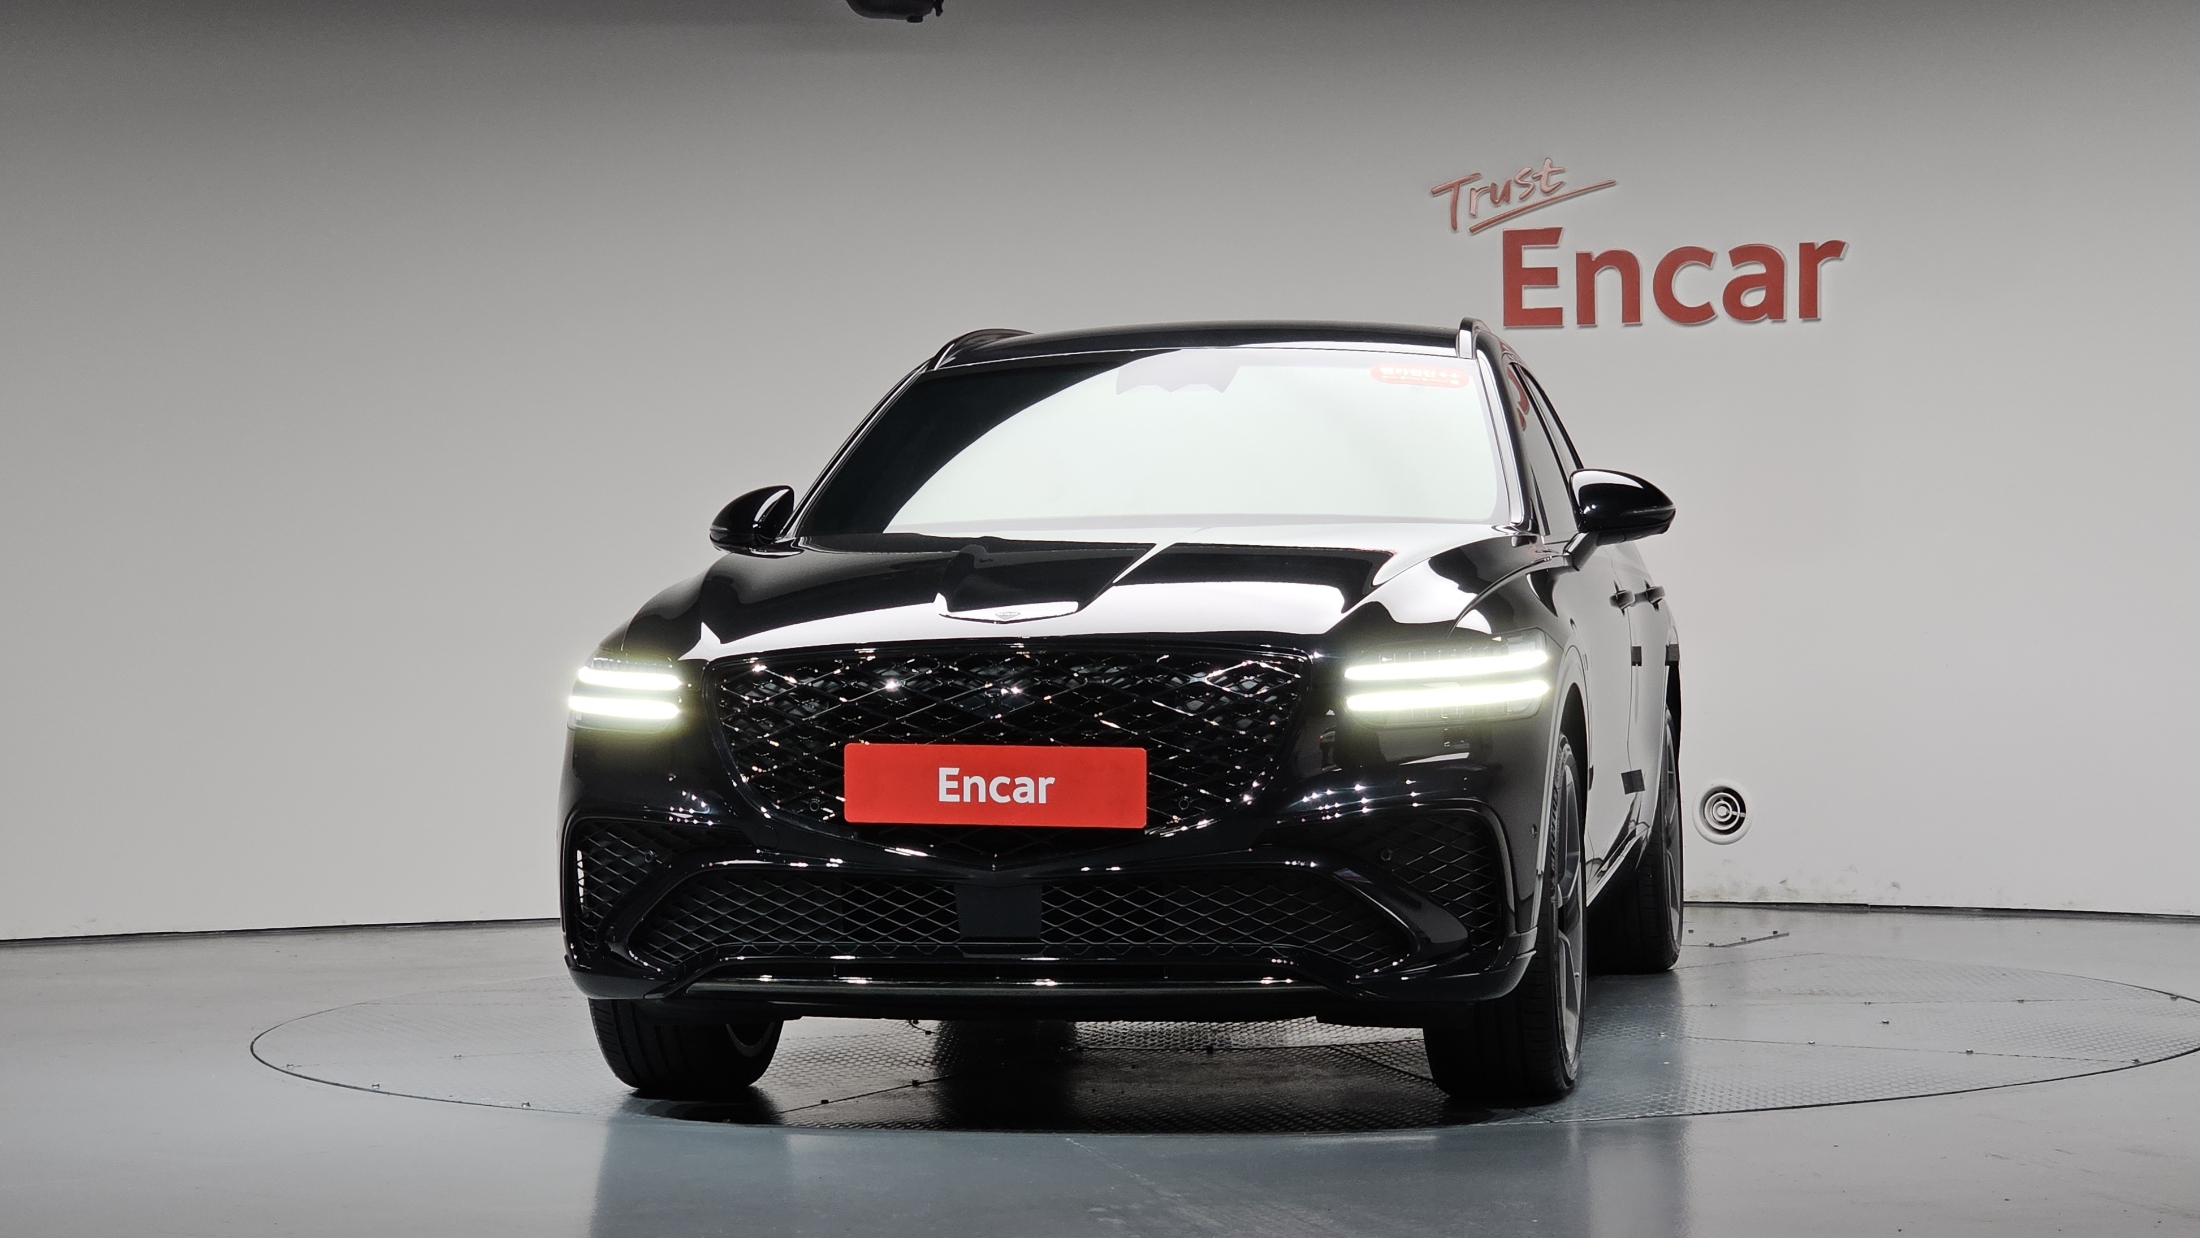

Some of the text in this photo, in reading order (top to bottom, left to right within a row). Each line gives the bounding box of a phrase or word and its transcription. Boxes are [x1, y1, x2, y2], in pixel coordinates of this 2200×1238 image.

[1431, 157, 1566, 232] Trust
[1502, 226, 1850, 329] Encar
[938, 767, 1056, 804] Encar
